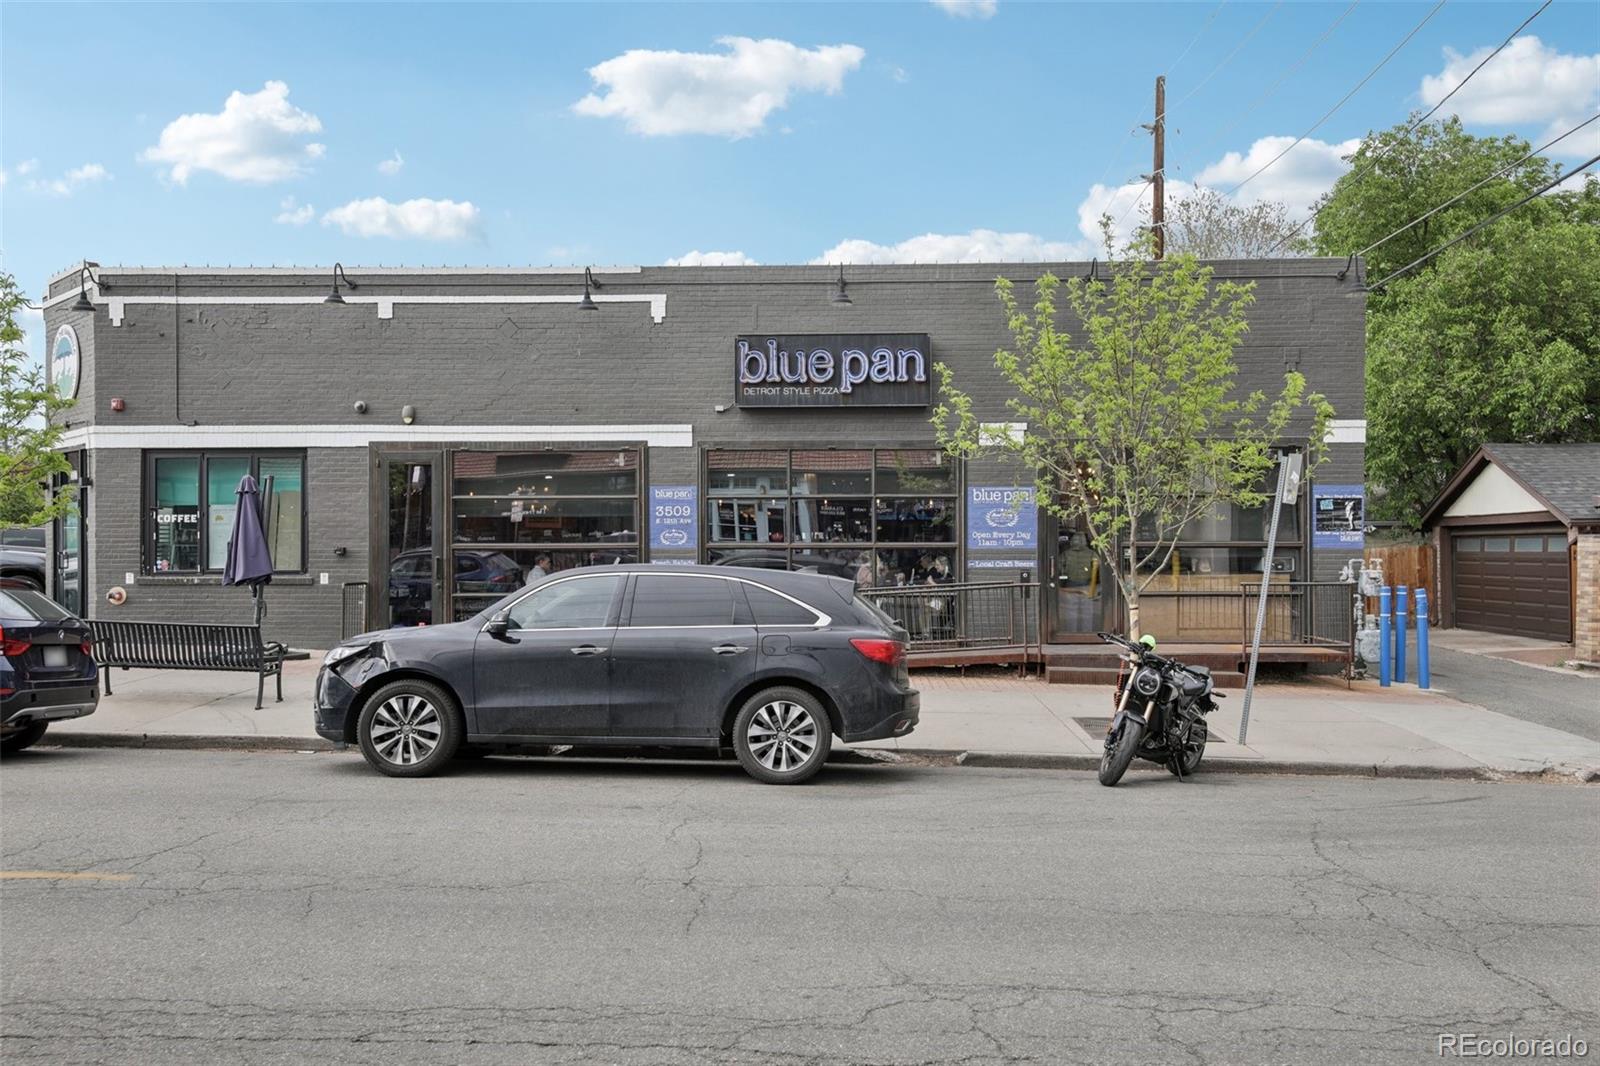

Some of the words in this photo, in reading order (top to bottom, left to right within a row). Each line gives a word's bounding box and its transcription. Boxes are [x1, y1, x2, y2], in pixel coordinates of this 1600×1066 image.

[738, 338, 835, 384] blue
[840, 347, 926, 393] pan
[743, 387, 780, 395] DETROIT
[783, 387, 810, 395] STYLE
[813, 387, 840, 395] PIZZA
[656, 489, 673, 498] blue
[973, 488, 1001, 501] blue
[656, 506, 691, 517] 3509
[157, 514, 197, 523] COFFEE
[972, 531, 991, 540] Open
[993, 531, 1015, 539] Every
[1016, 531, 1031, 540] Day
